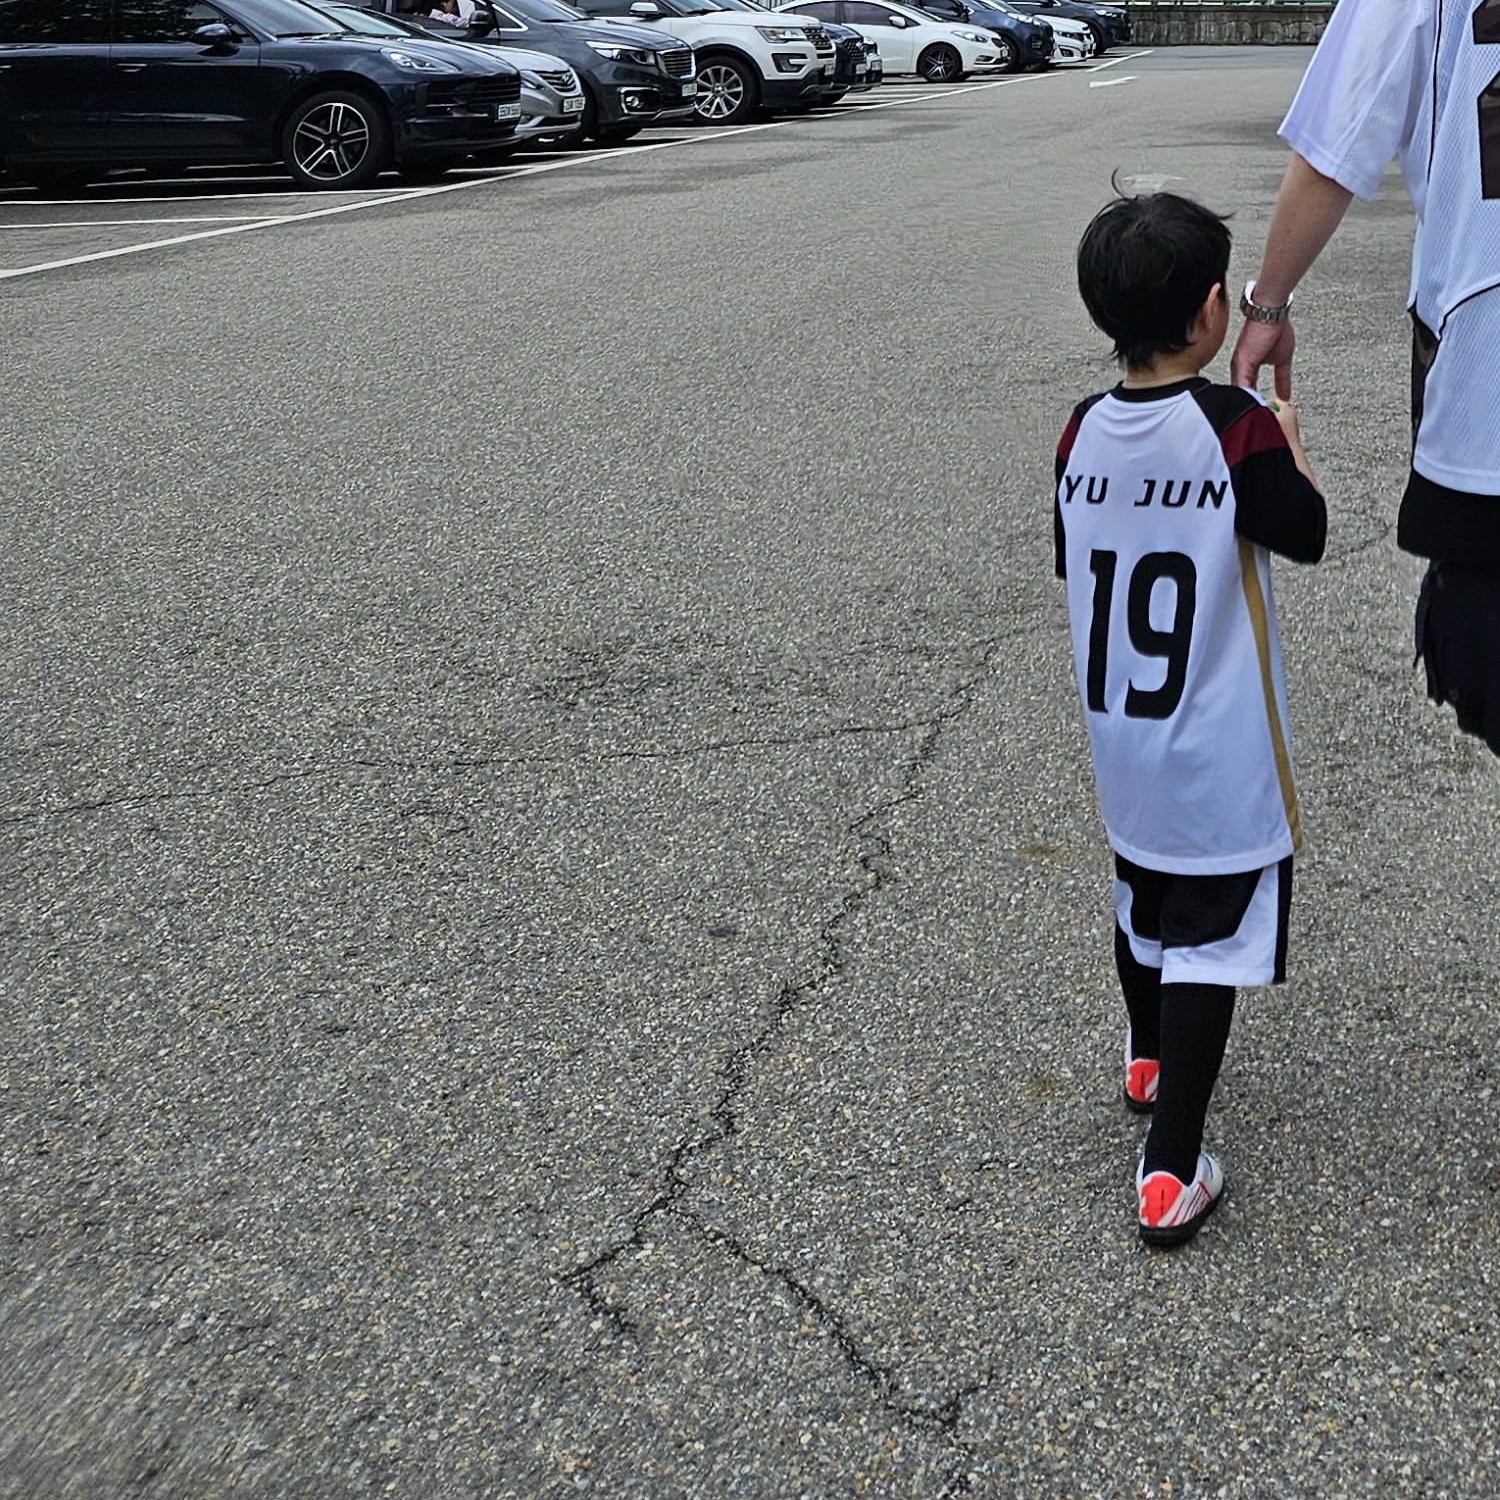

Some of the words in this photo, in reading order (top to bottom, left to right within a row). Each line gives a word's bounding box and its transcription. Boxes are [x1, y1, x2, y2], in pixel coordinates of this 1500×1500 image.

[1064, 475, 1109, 505] YU
[1133, 479, 1229, 510] JUN
[1087, 548, 1197, 720] 19
